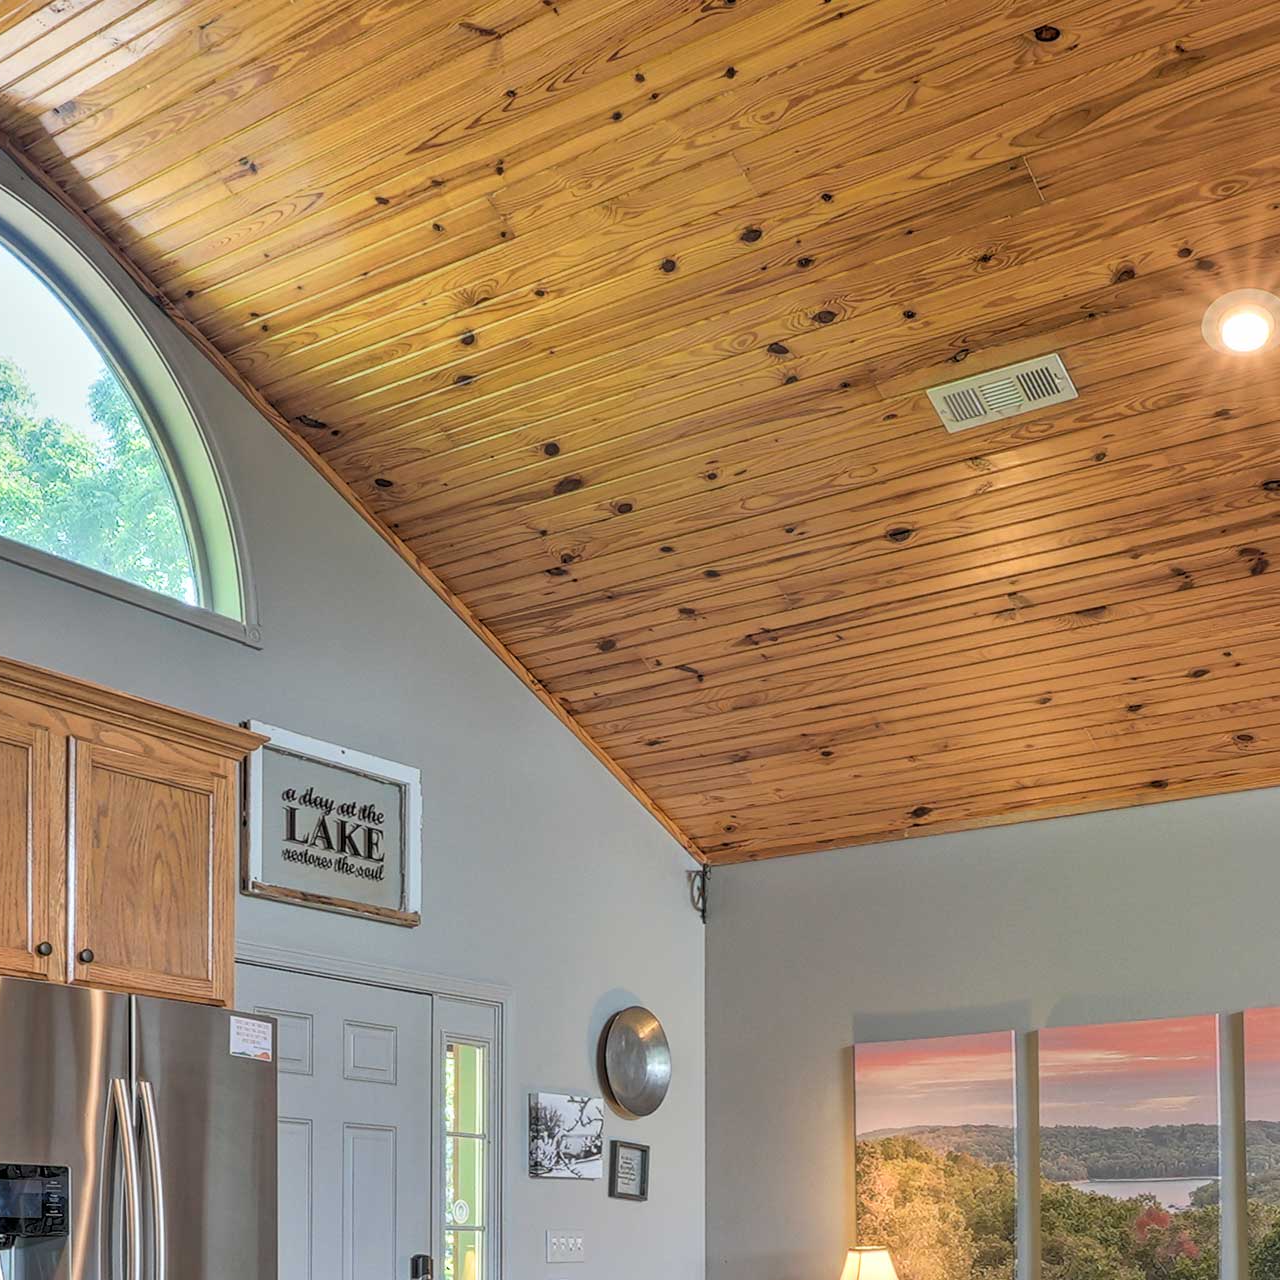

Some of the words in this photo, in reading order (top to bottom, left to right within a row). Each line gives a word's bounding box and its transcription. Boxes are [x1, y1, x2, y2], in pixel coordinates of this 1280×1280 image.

[283, 788, 297, 802] a
[300, 787, 335, 816] day
[337, 802, 358, 817] at
[359, 804, 384, 825] the
[282, 806, 385, 863] LAKE
[282, 848, 332, 870] restores
[334, 855, 355, 875] the
[355, 864, 384, 881] soul
